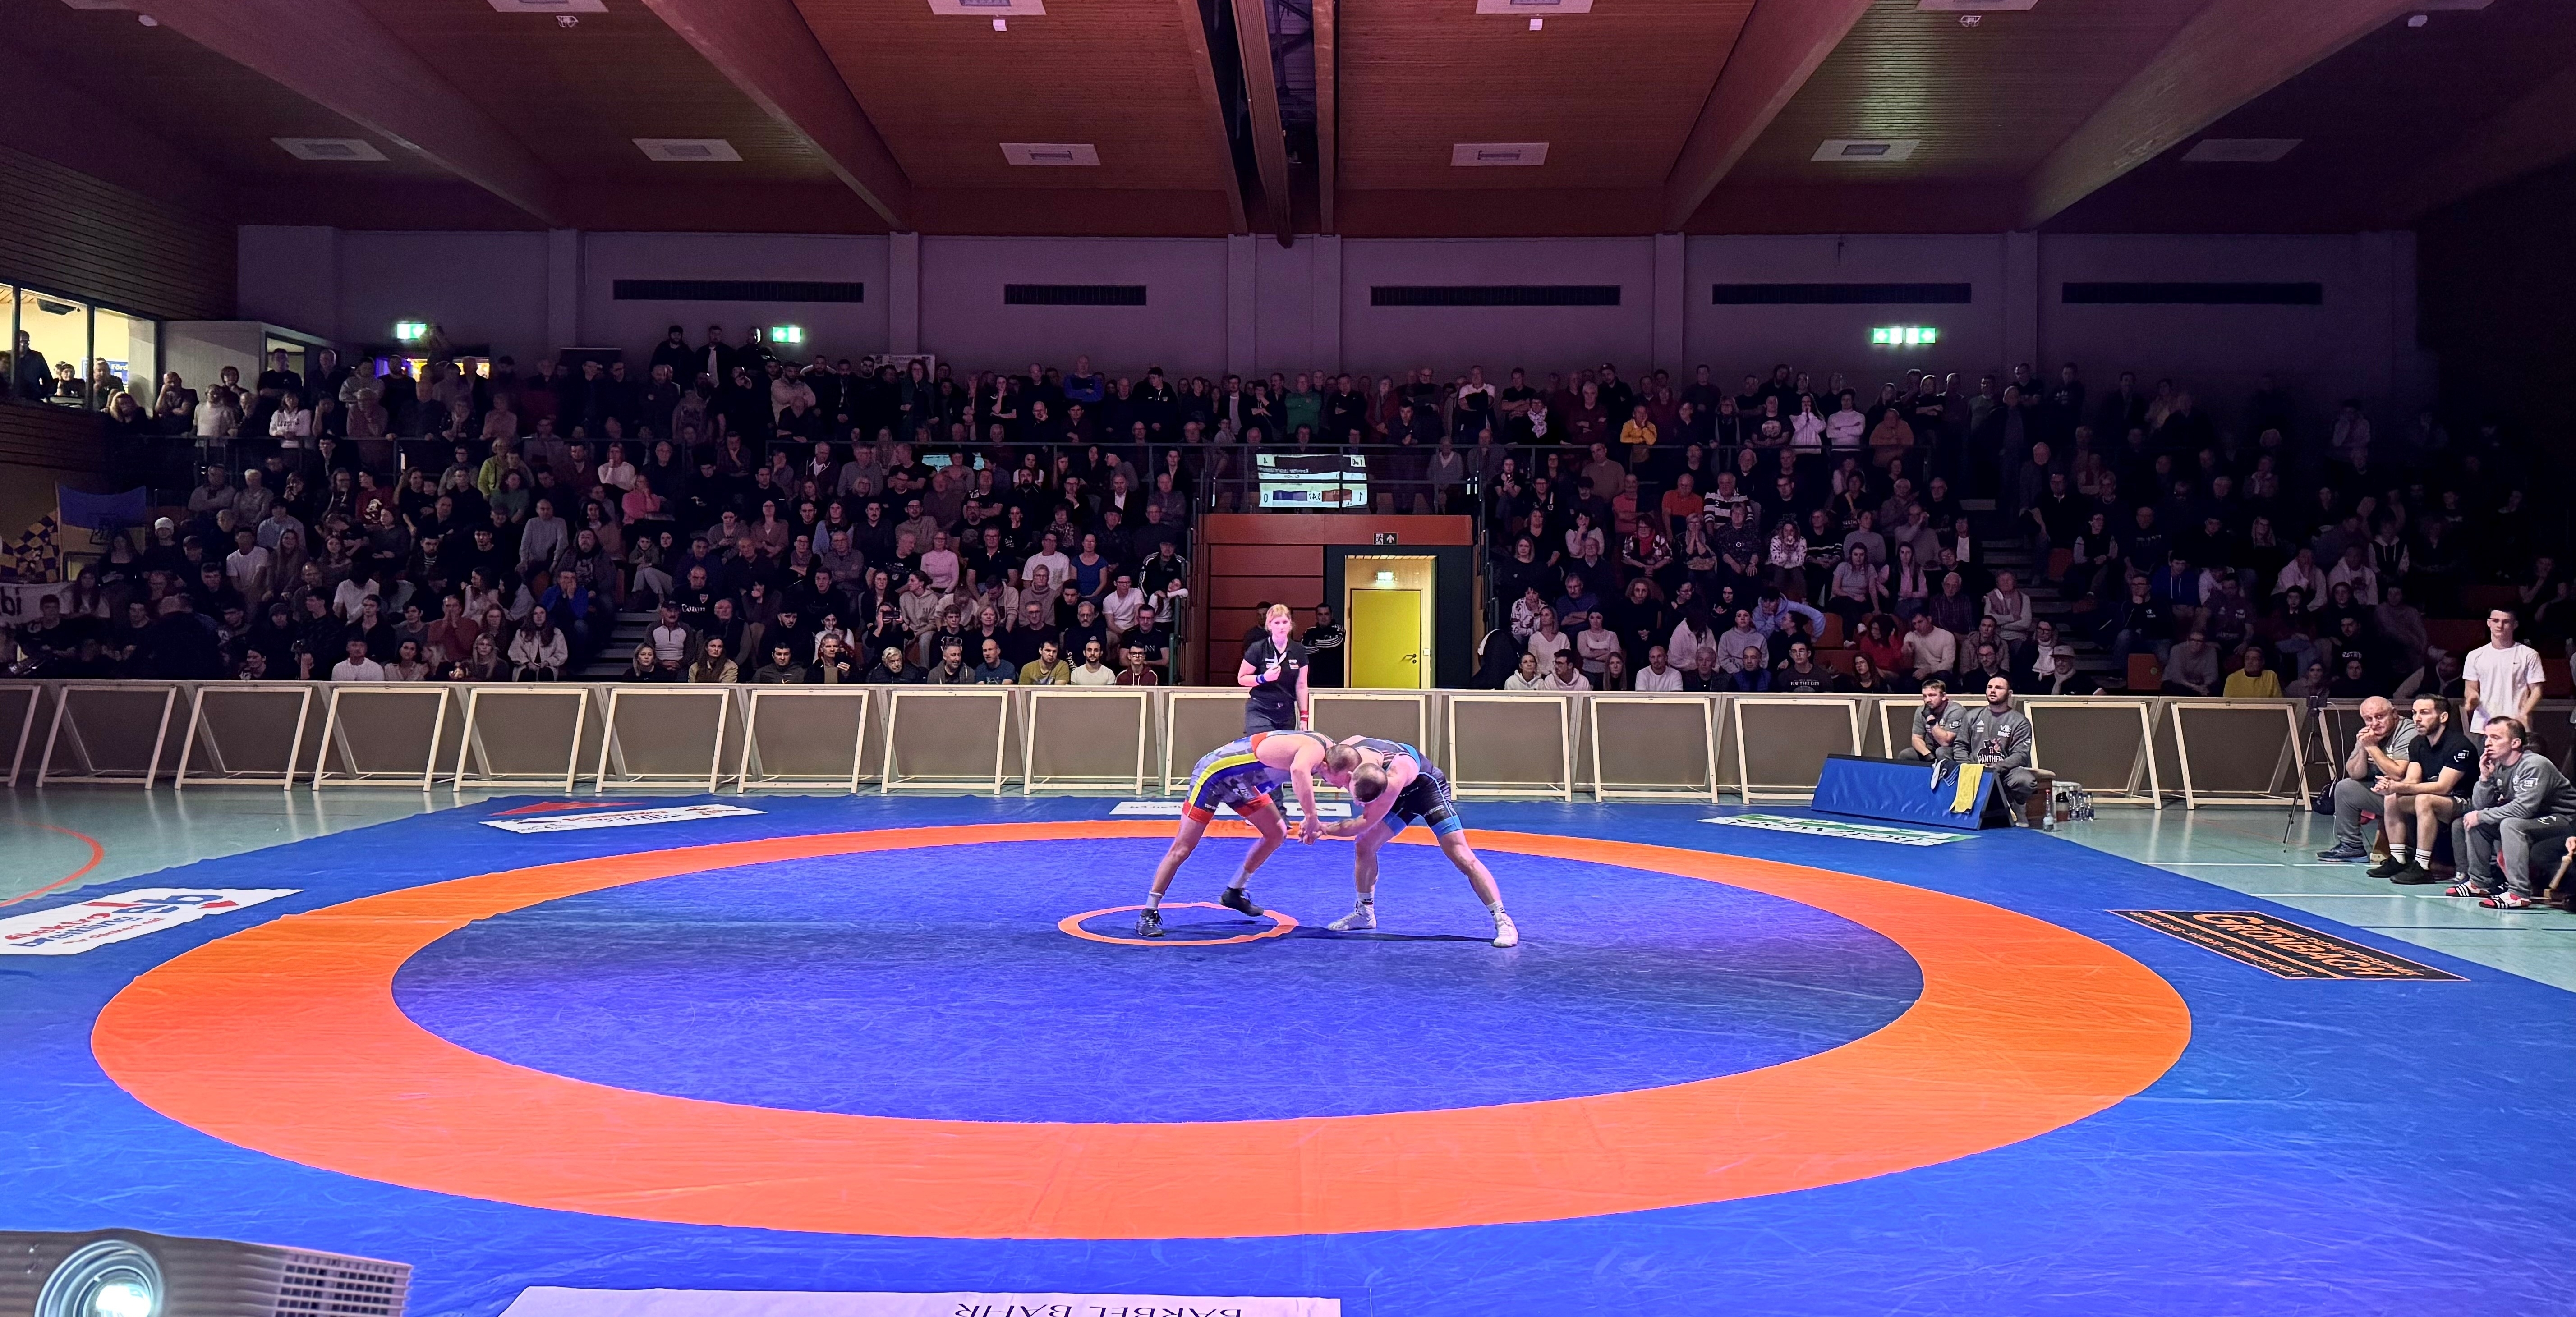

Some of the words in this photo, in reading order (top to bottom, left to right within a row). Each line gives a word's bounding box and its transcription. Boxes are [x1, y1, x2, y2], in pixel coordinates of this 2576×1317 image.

[5, 913, 111, 940] elektro
[7, 916, 143, 947] breitling
[2193, 913, 2400, 976] GRONBACH
